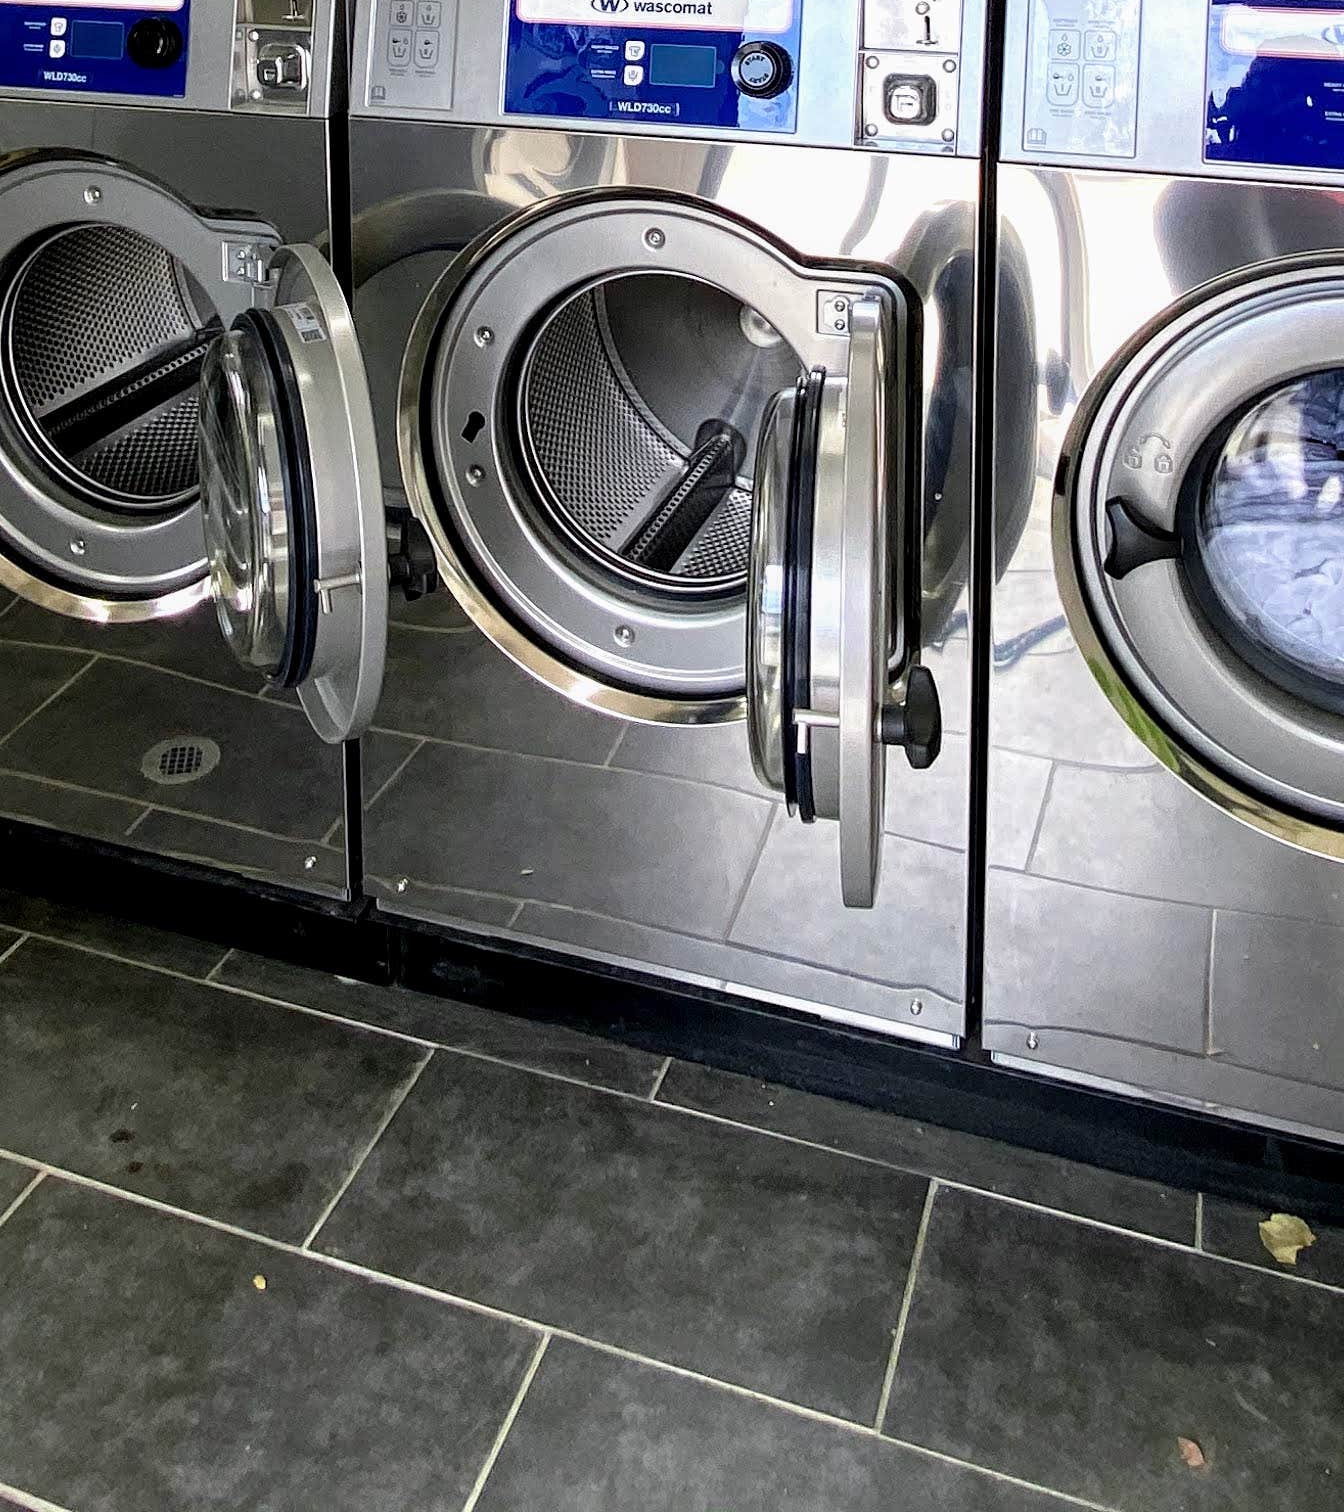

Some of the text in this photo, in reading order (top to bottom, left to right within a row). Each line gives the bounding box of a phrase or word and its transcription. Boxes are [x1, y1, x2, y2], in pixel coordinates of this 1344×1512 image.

[633, 1, 713, 15] wascomat
[744, 55, 766, 66] START
[43, 70, 88, 83] WLD730cc
[617, 101, 672, 114] WLD730cc
